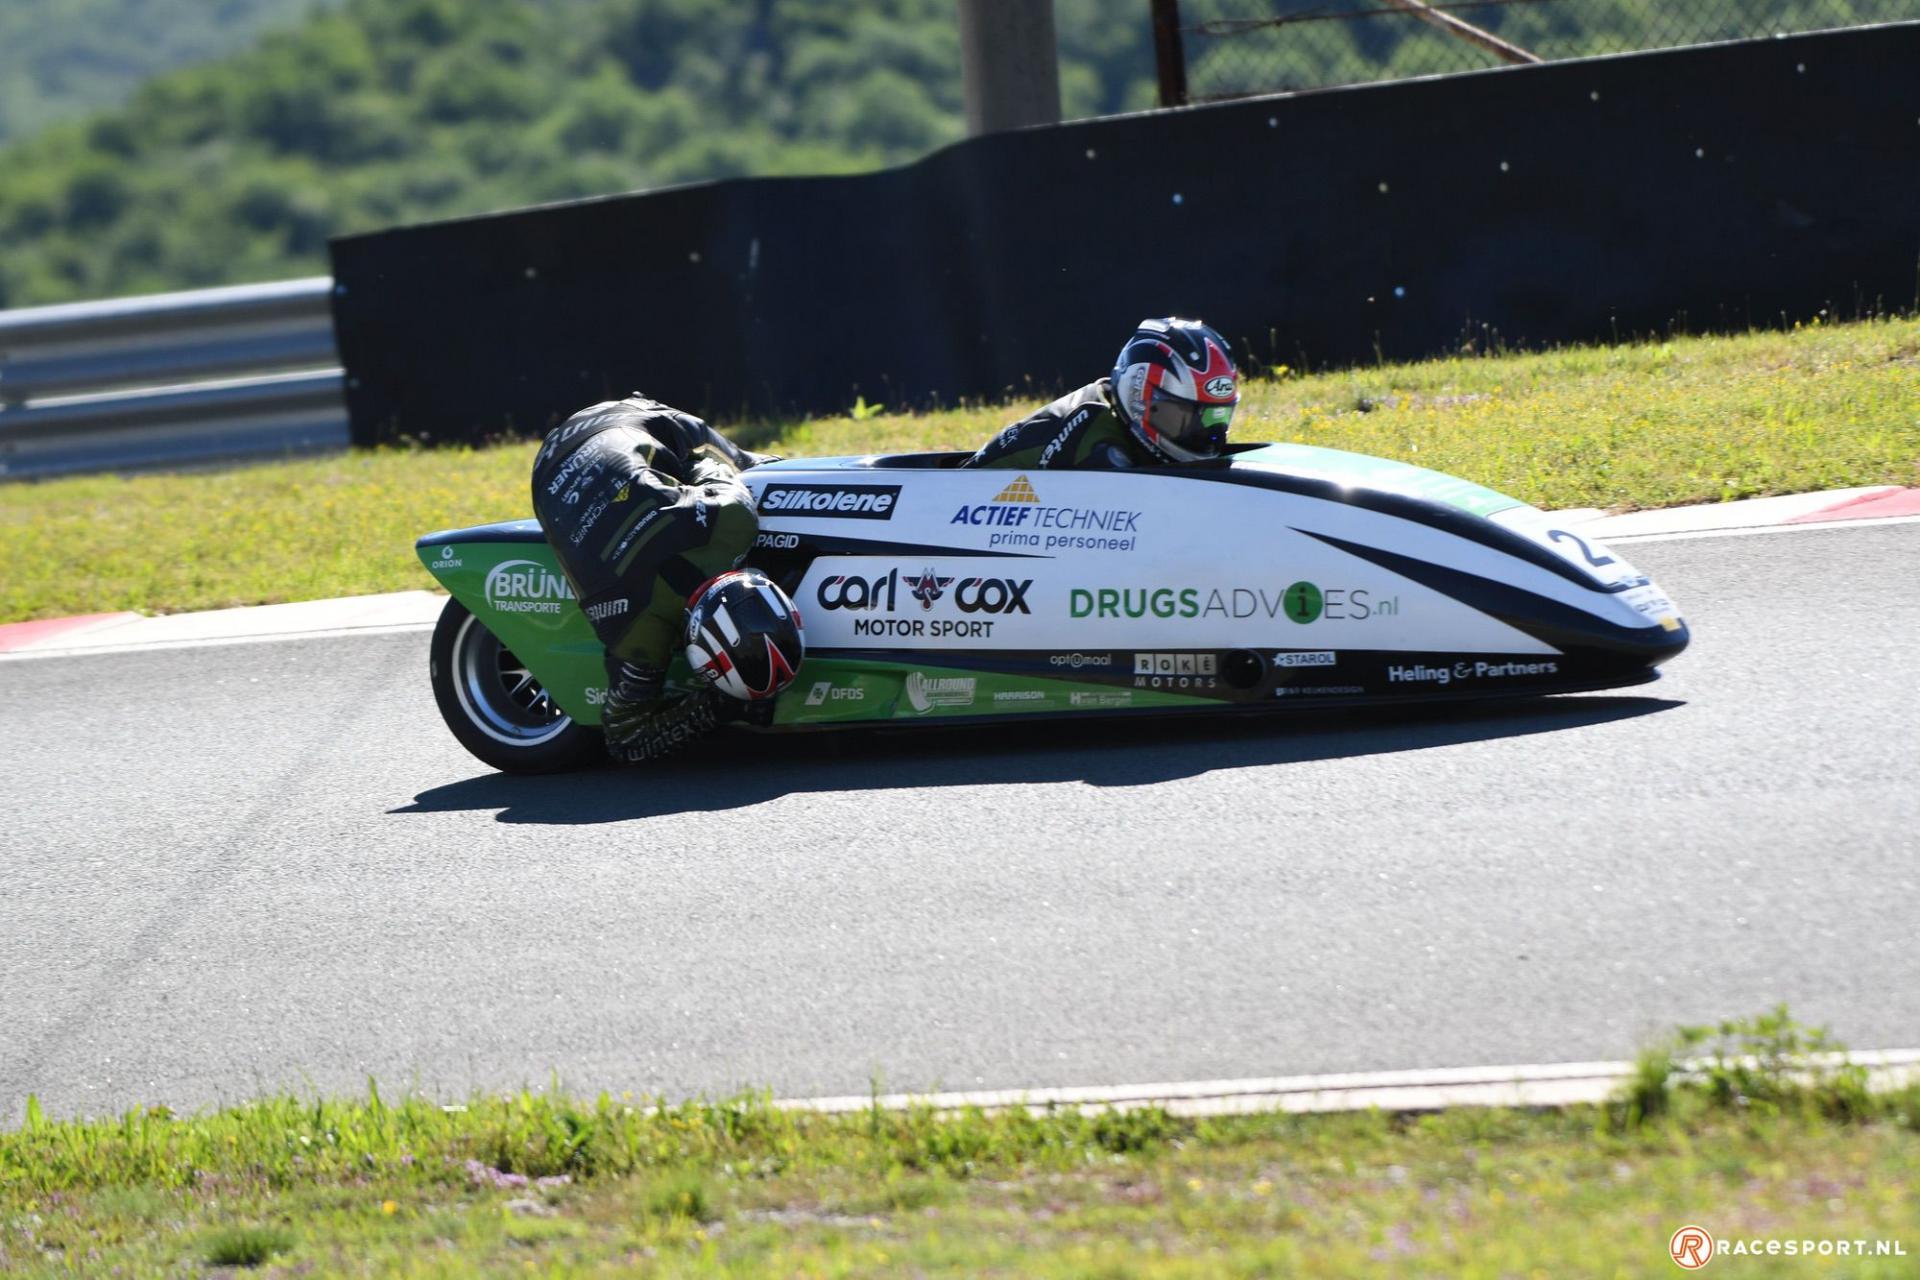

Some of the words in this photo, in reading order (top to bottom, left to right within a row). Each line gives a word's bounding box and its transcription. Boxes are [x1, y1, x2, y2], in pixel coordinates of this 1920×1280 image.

[1207, 378, 1232, 391] Ara
[763, 490, 893, 512] Silkolene
[950, 505, 1031, 526] ACTIEF
[1033, 507, 1142, 532] TECHNIEK
[756, 534, 799, 548] PAGID
[989, 530, 1040, 548] prima
[1045, 535, 1136, 551] personeel
[1546, 529, 1616, 567] 2
[432, 559, 462, 569] ORION
[494, 568, 575, 600] BRÜN
[494, 601, 561, 613] TRANSPORTE
[854, 619, 925, 637] MOTOR
[930, 620, 995, 638] SPORT
[1285, 653, 1335, 665] STAROL
[1388, 665, 1449, 684] Heling
[1453, 662, 1473, 679] &
[1475, 661, 1558, 677] Partners
[1134, 676, 1216, 688] MOTORS
[831, 688, 864, 700] DFDS
